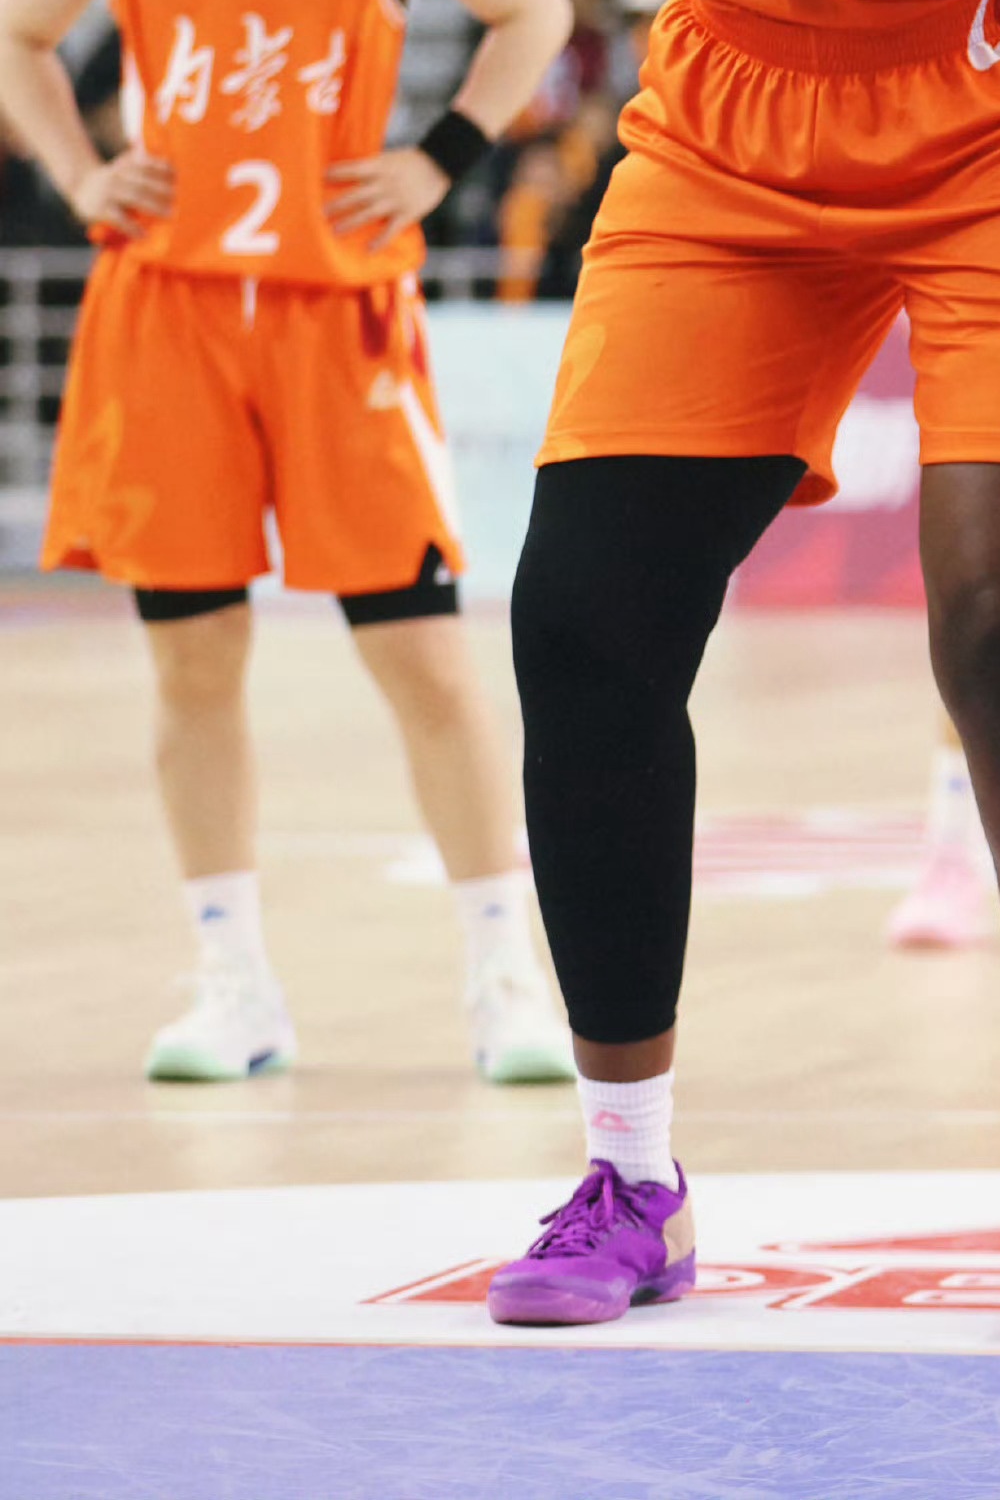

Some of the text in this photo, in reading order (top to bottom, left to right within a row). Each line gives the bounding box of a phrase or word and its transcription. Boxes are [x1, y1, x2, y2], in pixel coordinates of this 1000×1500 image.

[155, 11, 346, 133] 内蒙古
[221, 158, 283, 257] 2
